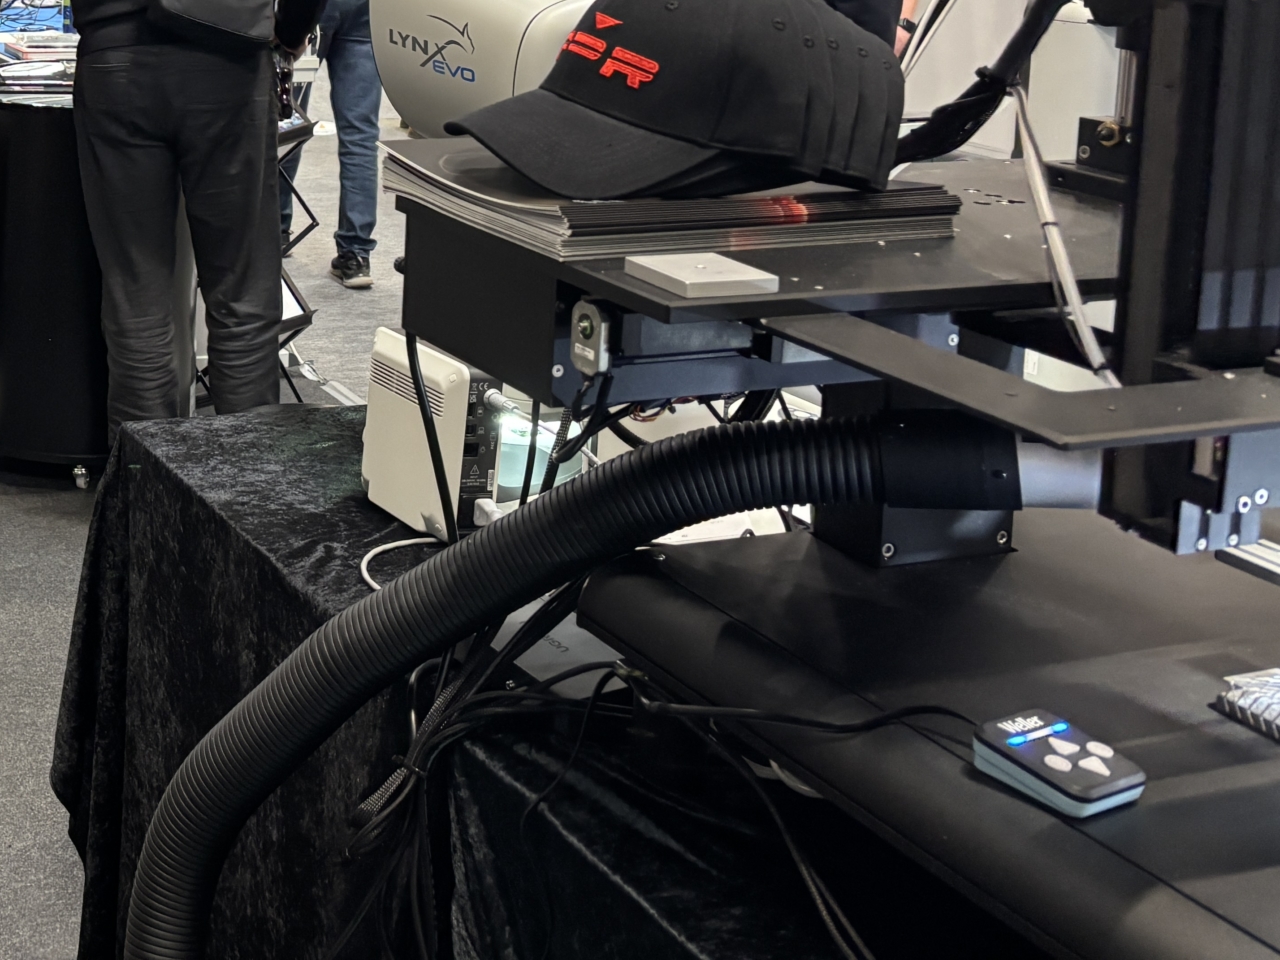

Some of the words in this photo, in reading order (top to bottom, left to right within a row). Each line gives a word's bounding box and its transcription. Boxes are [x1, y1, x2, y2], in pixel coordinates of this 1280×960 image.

[389, 28, 448, 68] LYNX
[432, 59, 475, 83] EVO
[997, 715, 1045, 734] Weller
